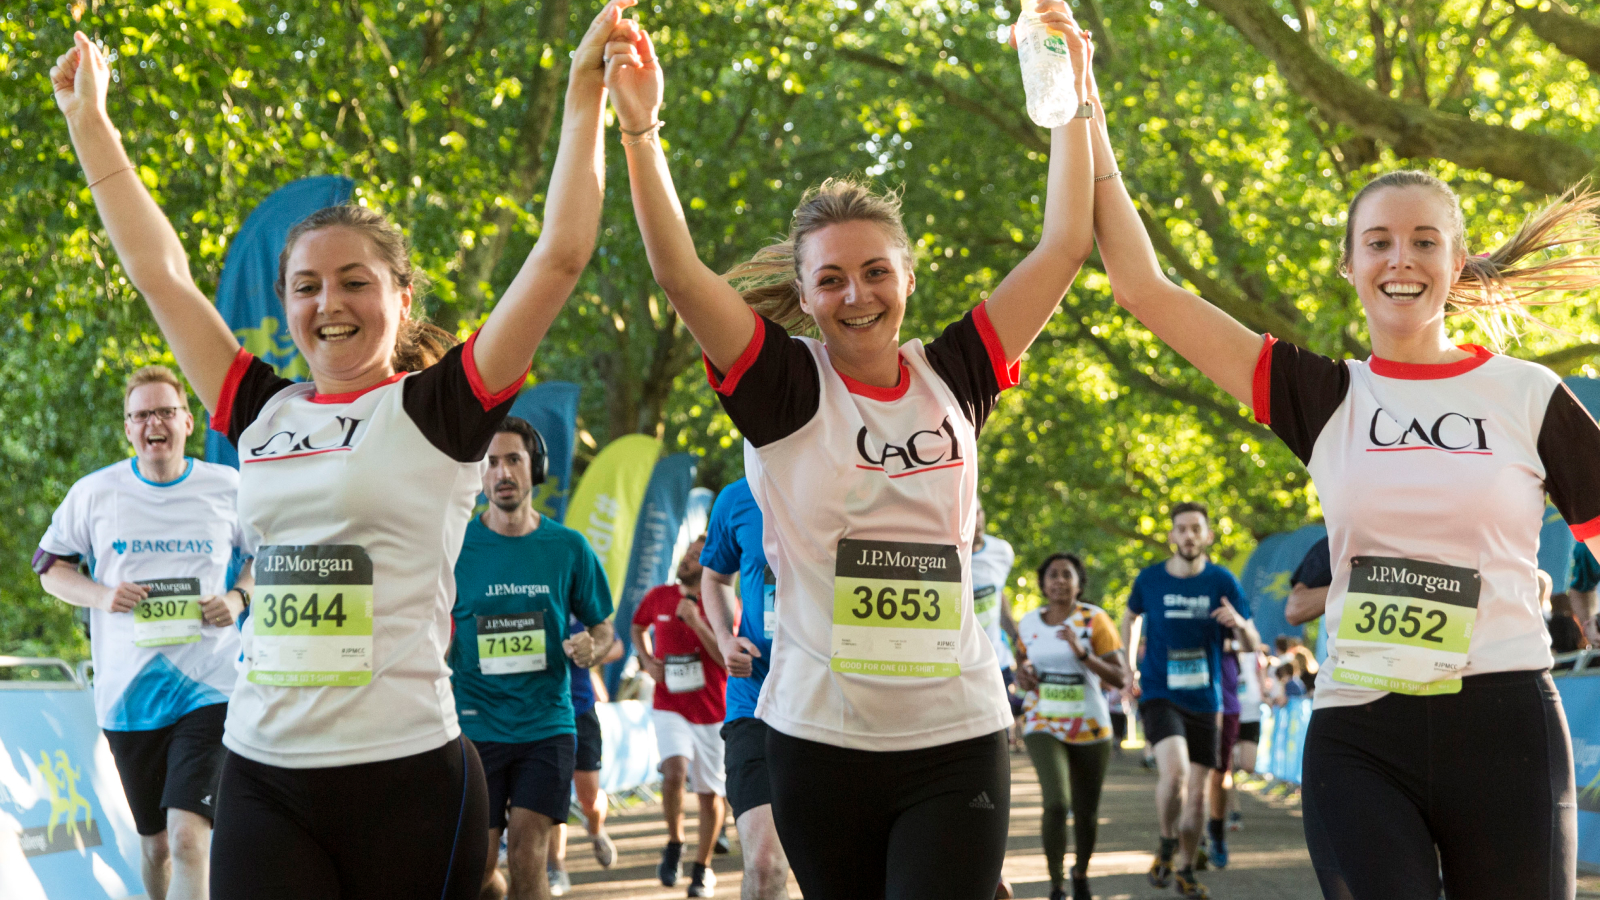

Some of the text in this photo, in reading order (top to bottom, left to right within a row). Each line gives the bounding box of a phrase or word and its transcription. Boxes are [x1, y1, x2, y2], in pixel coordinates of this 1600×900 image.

[1369, 408, 1492, 450] CACI
[856, 415, 964, 470] CACI
[587, 494, 621, 567] #JP
[131, 539, 214, 554] BARCLAYS
[264, 555, 354, 577] J.P.Morgan
[857, 549, 947, 574] J.P.Morgan
[485, 583, 550, 598] J.P.Morgan
[1367, 565, 1461, 593] J.P.Morgan
[141, 600, 188, 618] 3307
[263, 593, 347, 628] 3644
[851, 586, 941, 622] 3653
[485, 617, 535, 630] J.P.Morgan
[1355, 601, 1448, 644] 3652
[486, 635, 533, 654] 7132
[840, 661, 862, 670] GOOD
[864, 662, 879, 671] FOR
[880, 663, 896, 671] ONE
[898, 664, 907, 672] (1)
[909, 664, 936, 673] T-SHIRT
[1340, 671, 1360, 681] GOOD
[1360, 675, 1374, 684] FOR
[1374, 678, 1388, 687] ONE
[1389, 680, 1399, 689] (1)
